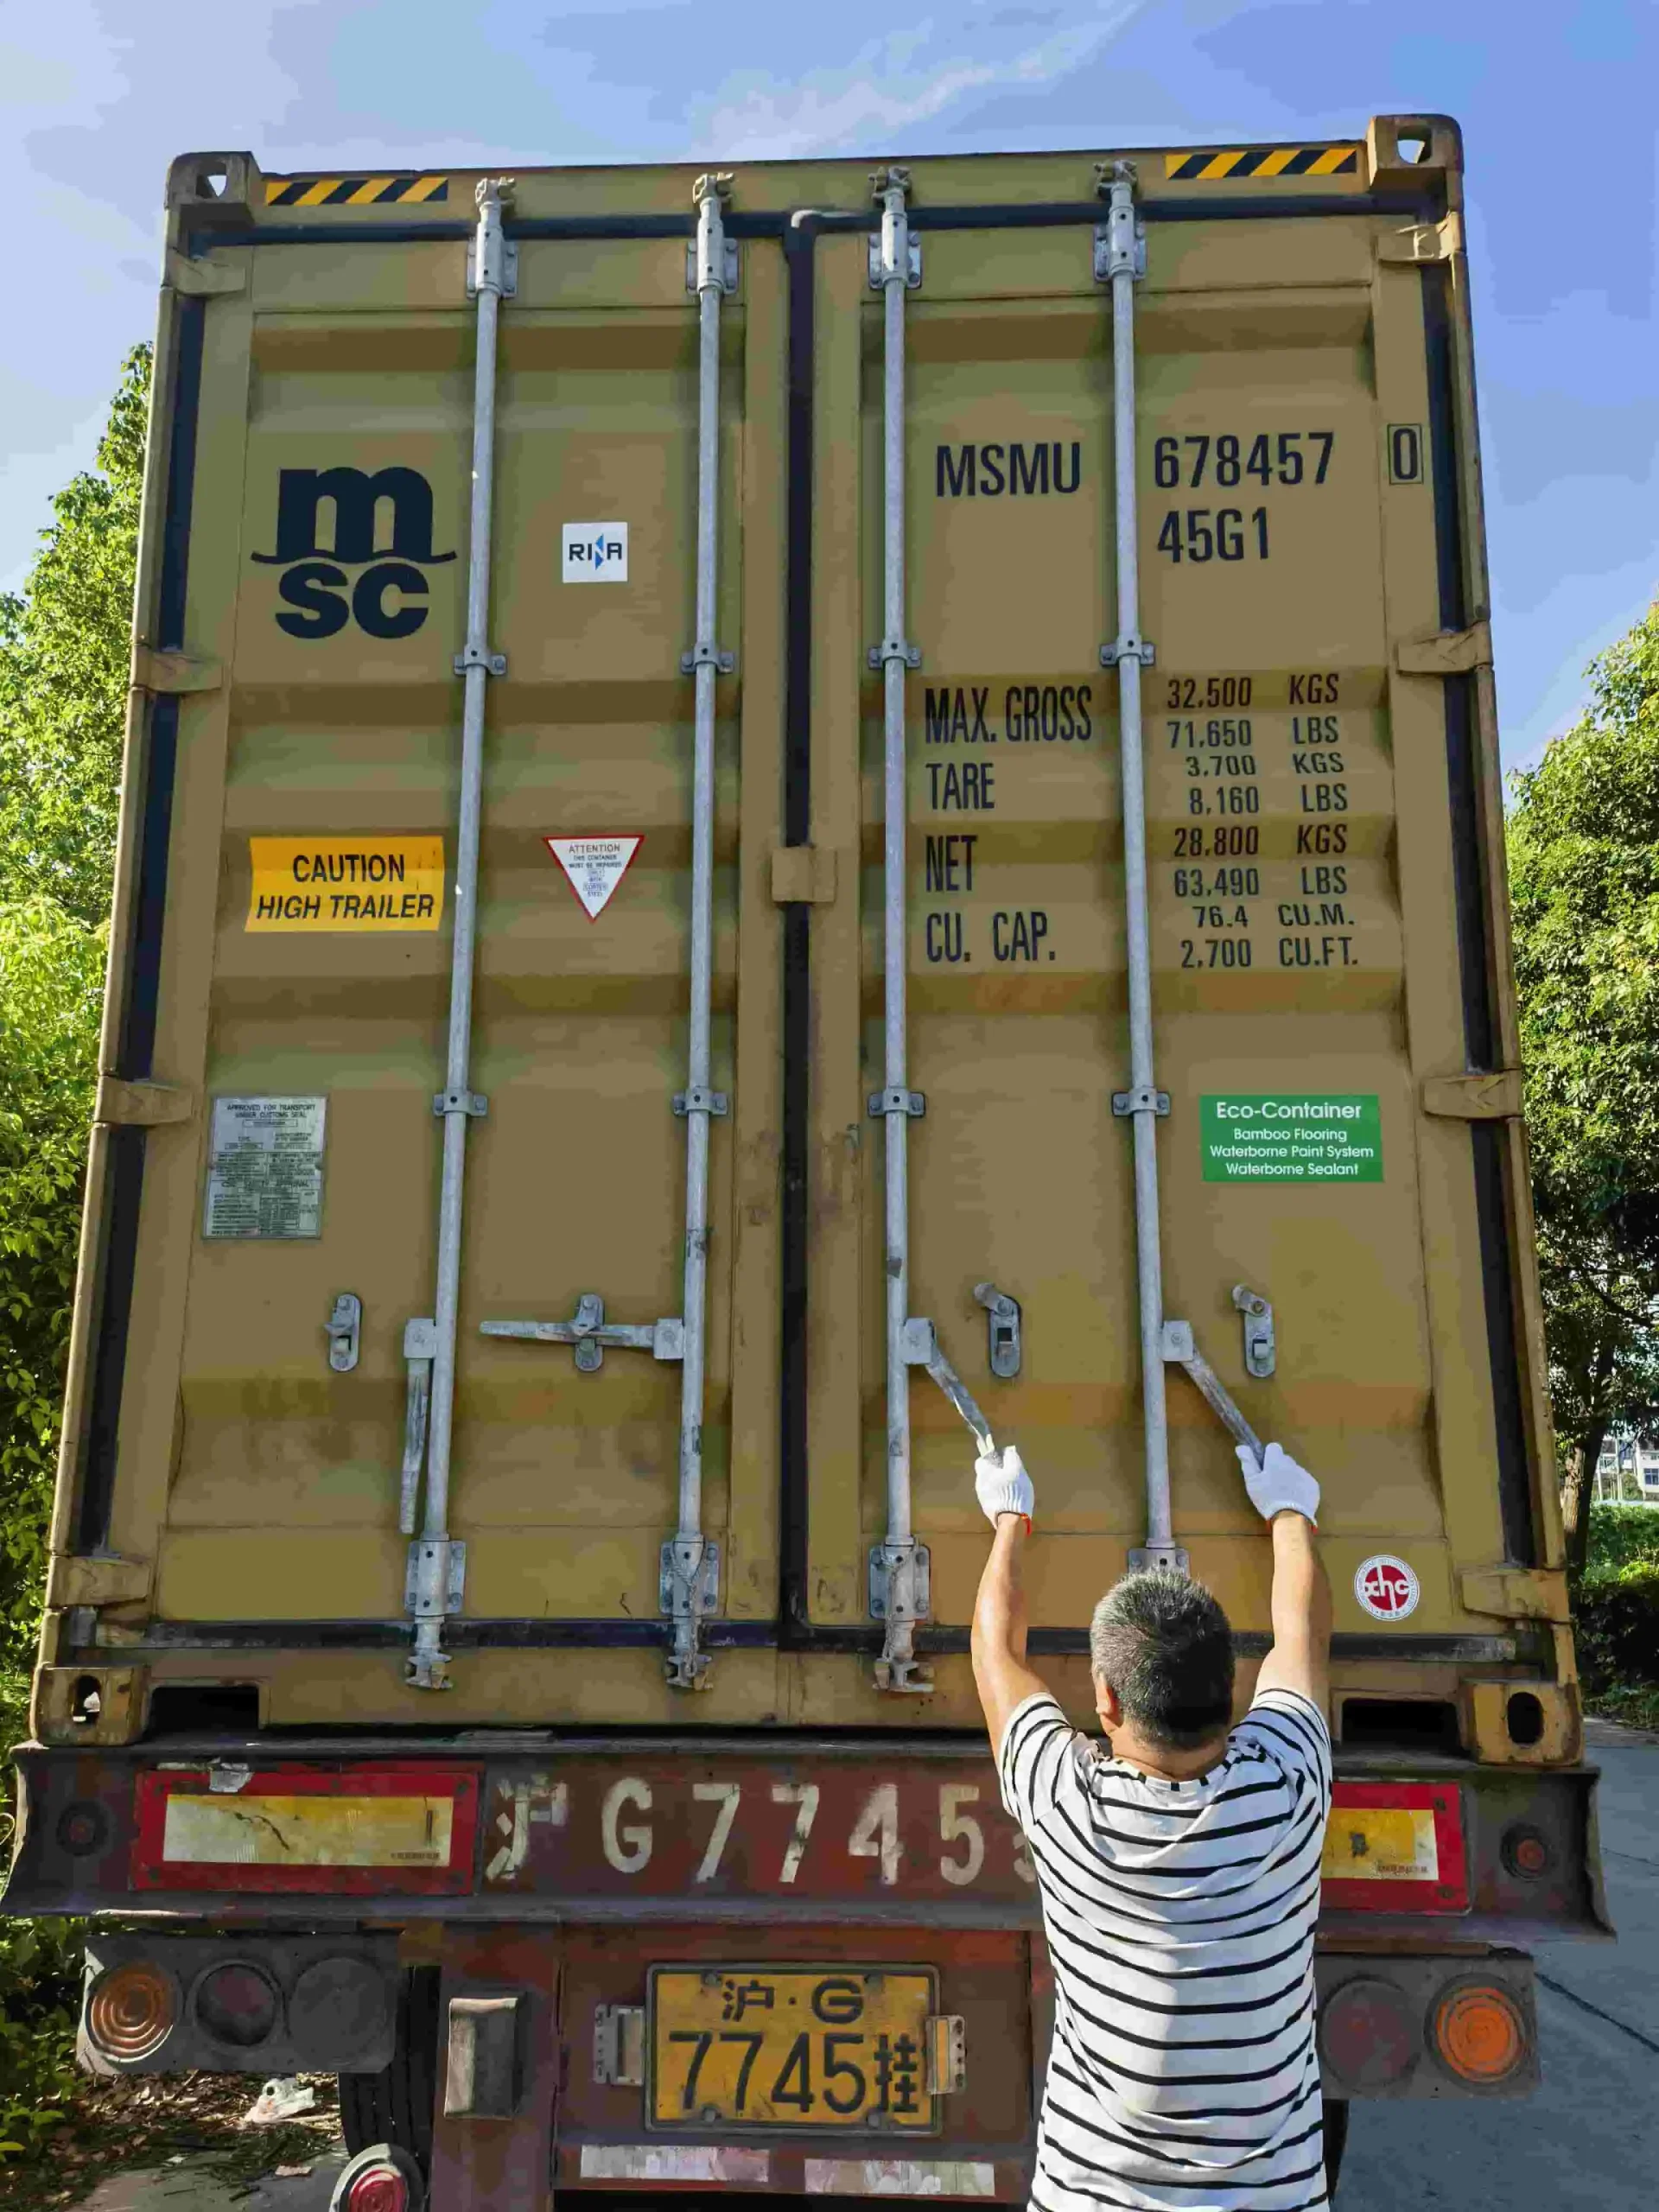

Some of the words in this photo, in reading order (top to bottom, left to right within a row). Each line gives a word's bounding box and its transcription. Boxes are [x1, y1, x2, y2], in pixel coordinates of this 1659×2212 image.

[936, 442, 1081, 497] MSMU
[1154, 431, 1335, 488] 678457
[1157, 506, 1269, 563] 45G1
[1288, 673, 1340, 706] KGS
[925, 687, 997, 744] MAX.
[1005, 685, 1092, 743] GROSS
[1293, 715, 1340, 746] LBS
[1293, 751, 1344, 775] KGS
[925, 762, 995, 810] TARE
[1301, 782, 1349, 813] LBS
[569, 843, 620, 854] ATTENTION
[1296, 823, 1349, 855] KGS
[292, 854, 405, 882] CAUTION
[925, 833, 978, 893] NET
[1300, 865, 1349, 896] LBS
[256, 894, 321, 919] HIGH
[330, 893, 435, 918] TRAILER
[1192, 905, 1249, 929] 76.4
[1277, 902, 1355, 928] CU.M.
[925, 912, 972, 963] CU.
[993, 911, 1057, 962] CAP.
[1279, 936, 1359, 967] CU.FT.
[1216, 1102, 1362, 1119] Eco-Container
[1233, 1128, 1291, 1141] Bamboo
[1294, 1127, 1348, 1142] Flooring
[1210, 1145, 1288, 1159] Waterborne
[1291, 1145, 1324, 1158] Paint
[1326, 1145, 1374, 1160] System
[1225, 1162, 1305, 1176] Waterborne
[1307, 1162, 1358, 1175] Sealant
[669, 2031, 919, 2114] 7745挂
